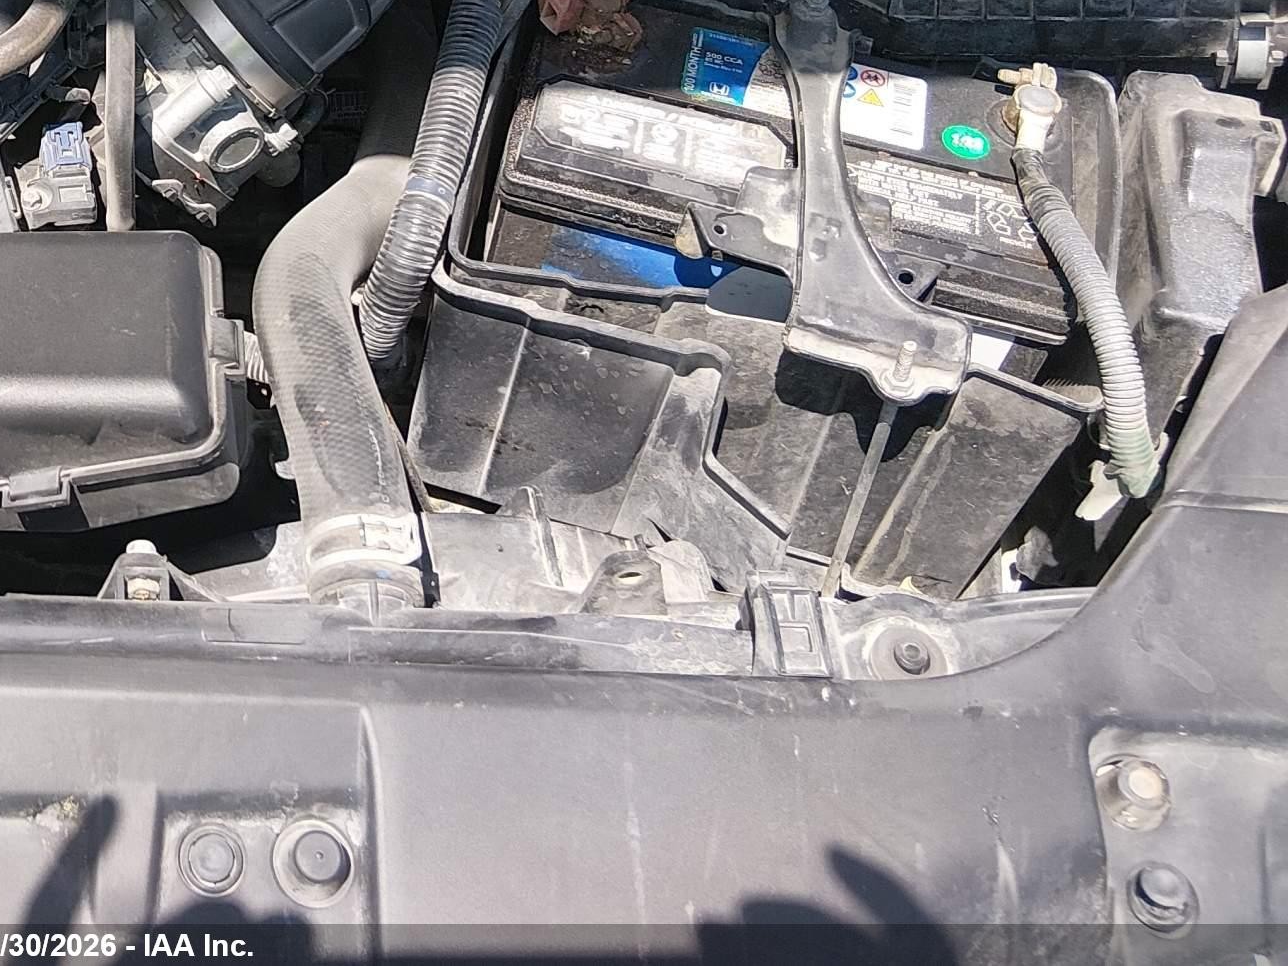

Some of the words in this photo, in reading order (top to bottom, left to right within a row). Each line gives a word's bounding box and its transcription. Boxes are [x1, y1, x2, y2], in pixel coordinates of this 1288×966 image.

[687, 46, 702, 76] MONTH
[705, 52, 723, 61] 500
[723, 55, 744, 65] CCA
